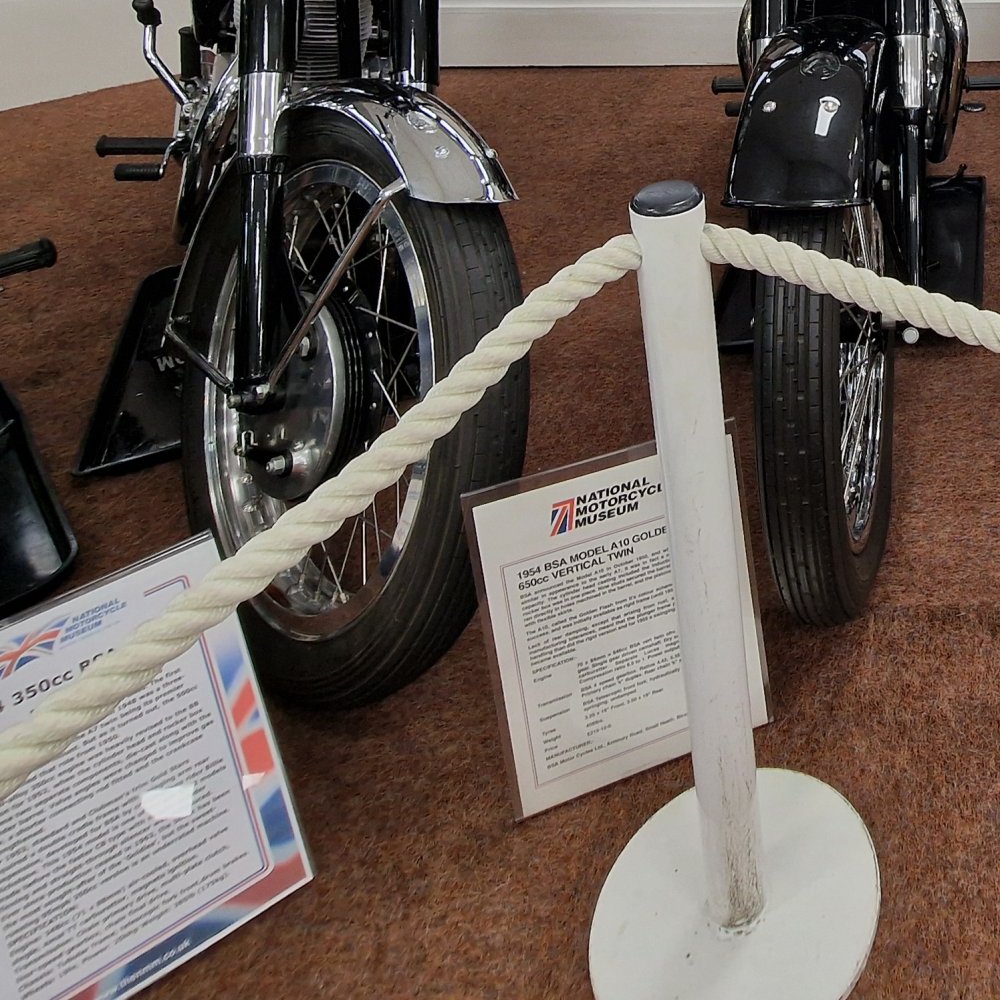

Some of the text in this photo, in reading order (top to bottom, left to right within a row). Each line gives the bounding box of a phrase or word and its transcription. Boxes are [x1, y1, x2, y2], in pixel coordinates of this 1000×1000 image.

[576, 477, 650, 505] NATIONAL
[576, 483, 662, 517] MOTORCYCL
[575, 502, 639, 528] MUSEUM
[518, 526, 667, 580] 1954 BSA MODEL A10 GOLDE
[518, 546, 634, 591] 650cc VERTICAL TWIN
[64, 601, 128, 632] MOTORCYCLE
[72, 598, 120, 623] NATIONAL
[60, 620, 102, 644] MUSEUM
[11, 670, 74, 706] 350cc
